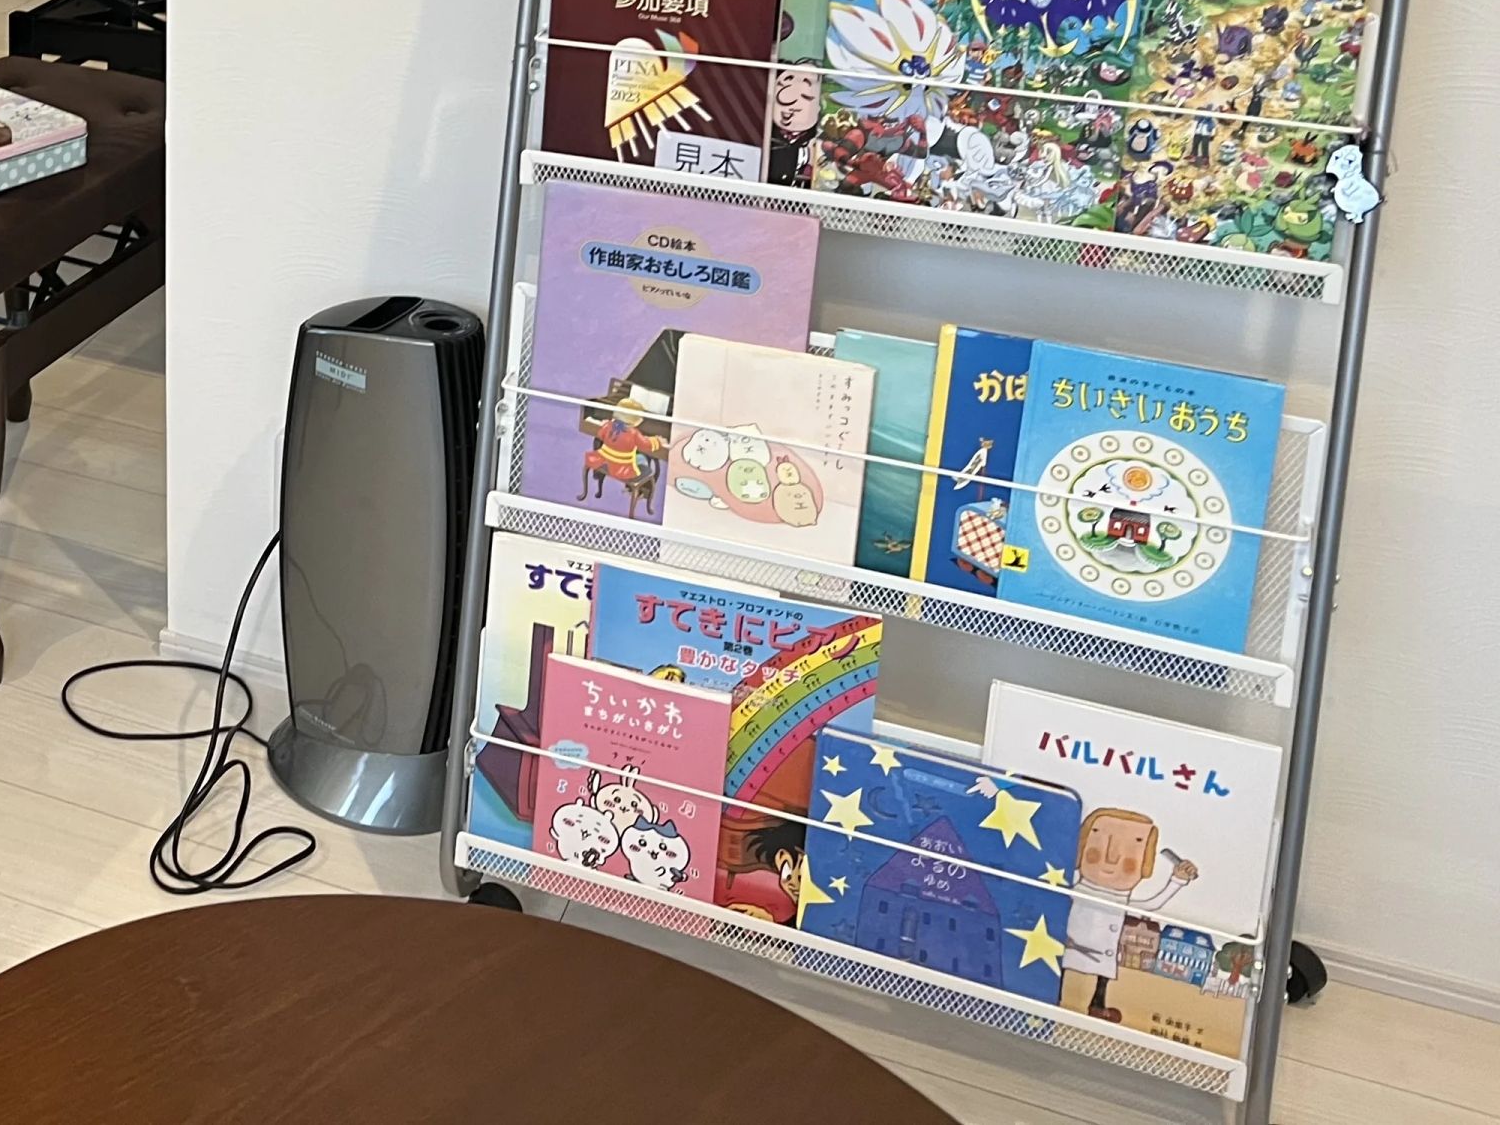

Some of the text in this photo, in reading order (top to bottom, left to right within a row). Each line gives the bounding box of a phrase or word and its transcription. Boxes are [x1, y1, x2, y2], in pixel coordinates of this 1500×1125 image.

[610, 90, 641, 104] 2023
[675, 142, 745, 180] 見本
[647, 234, 696, 252] CD絵本
[588, 246, 751, 290] 作曲家おもしろ図鑑
[1051, 376, 1249, 443] ちいさいおうち
[679, 589, 804, 621] マエストロ・プロフォンドの
[634, 592, 860, 660] すてきにピアノ
[677, 645, 802, 683] 豊かなタッチ
[723, 641, 754, 656] 第2巻
[581, 680, 684, 725] ちいかわ
[583, 705, 684, 739] まちがいさがし
[1038, 731, 1230, 797] バルバルさん
[919, 836, 964, 854] あおい
[910, 855, 967, 880] よるの
[923, 874, 950, 892] ゆめ
